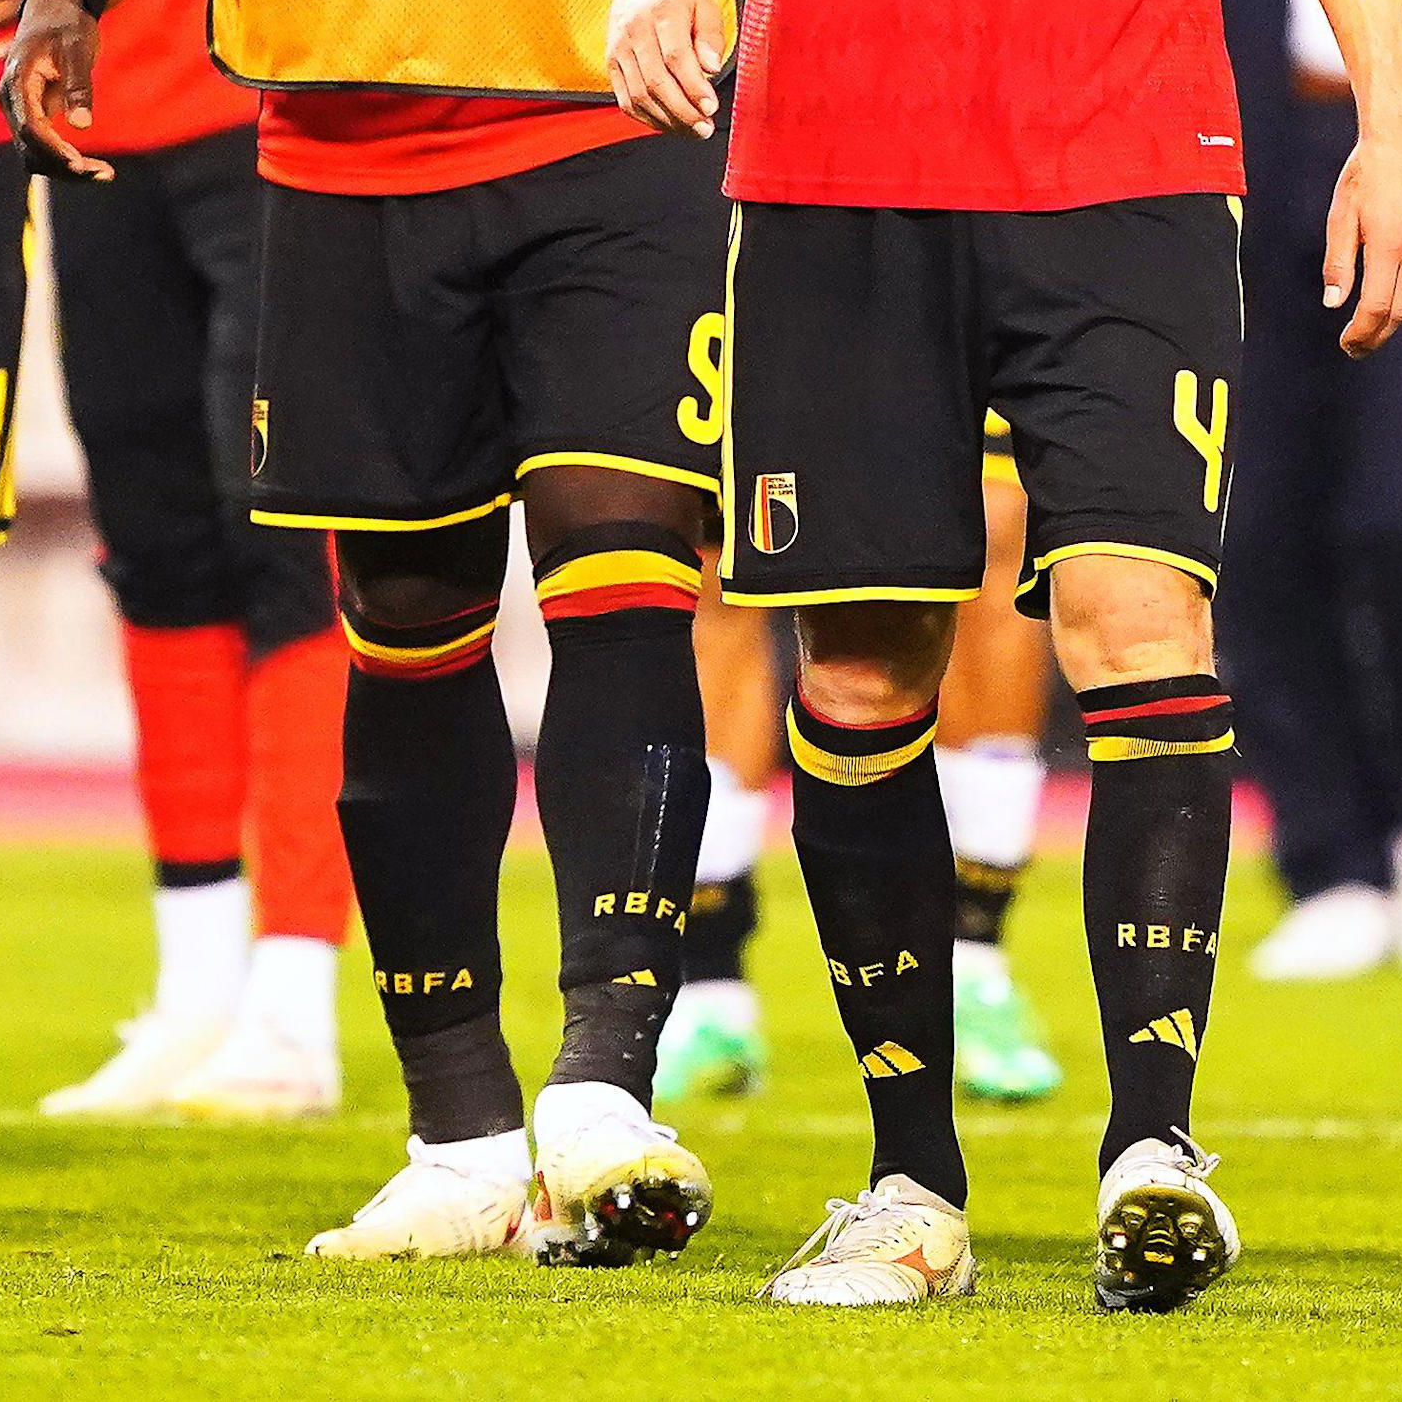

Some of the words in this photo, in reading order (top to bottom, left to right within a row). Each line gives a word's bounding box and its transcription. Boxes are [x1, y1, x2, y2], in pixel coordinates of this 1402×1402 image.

[1173, 369, 1230, 514] 4
[592, 891, 687, 937] RBFA
[1117, 922, 1218, 958] RBFA
[829, 949, 919, 987] BFA
